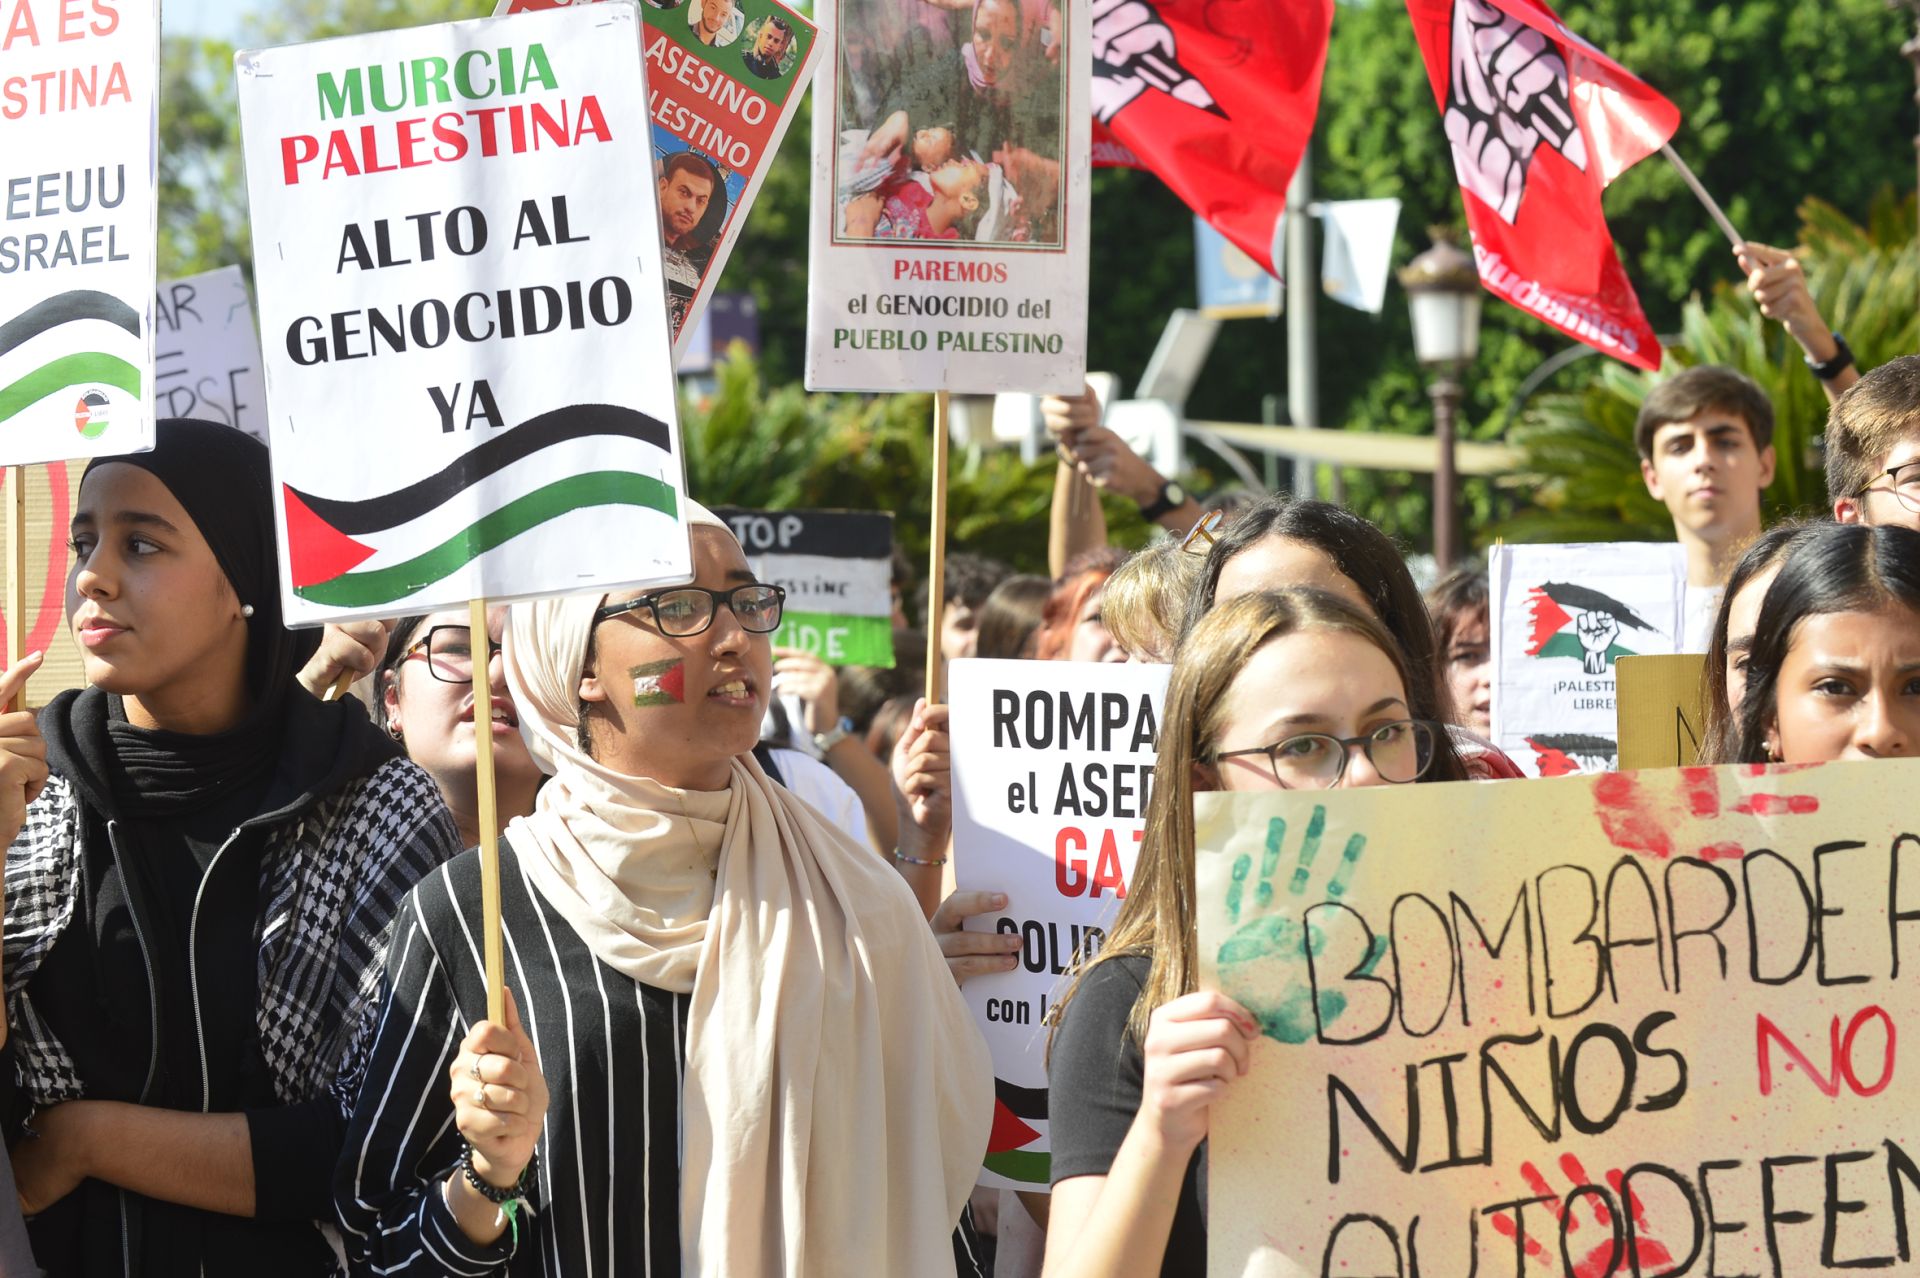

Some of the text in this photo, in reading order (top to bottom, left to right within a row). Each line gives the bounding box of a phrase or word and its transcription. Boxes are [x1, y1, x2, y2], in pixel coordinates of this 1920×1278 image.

[58, 0, 120, 42] ES
[2, 61, 132, 120] STINA
[316, 43, 559, 121] MURCIA
[645, 35, 767, 126] ASESINO
[280, 95, 613, 186] PALESTINA
[6, 164, 125, 221] EEUU
[0, 225, 130, 274] SRAEL
[336, 195, 590, 274] ALTO AL
[893, 259, 1008, 284] PAREMOS
[1470, 228, 1638, 356] studiantes
[286, 276, 632, 366] GENOCIDIO
[848, 293, 1051, 320] el GENOCIDIO del
[834, 328, 1063, 355] PUEBLO PALESTINO
[427, 379, 505, 433] YA
[730, 515, 803, 548] TOP
[993, 689, 1160, 753] ROMPA
[1008, 771, 1038, 814] el
[1055, 827, 1144, 898] GA
[986, 998, 1029, 1024] con
[1328, 1005, 1896, 1184] NIÑOS NO
